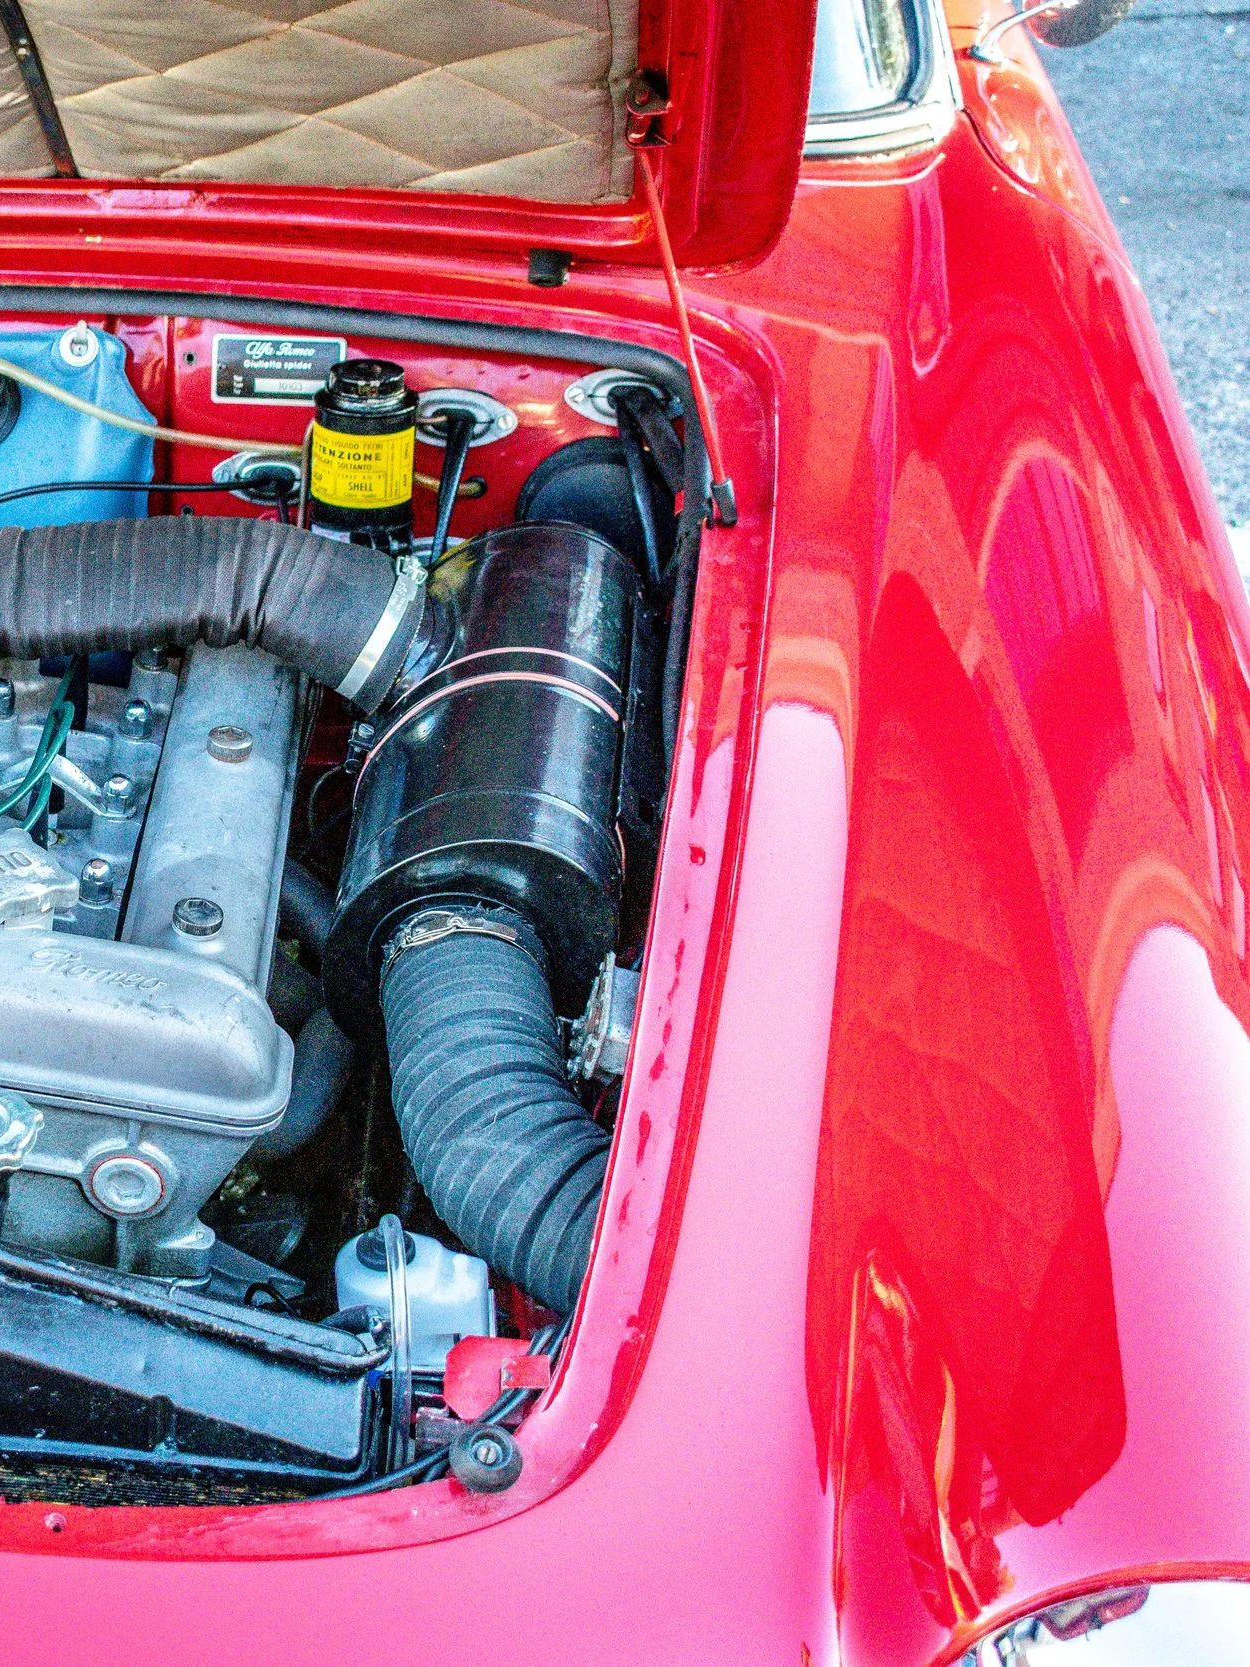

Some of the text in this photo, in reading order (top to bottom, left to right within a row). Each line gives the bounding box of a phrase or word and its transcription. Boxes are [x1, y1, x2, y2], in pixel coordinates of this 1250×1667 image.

[245, 342, 316, 359] Alfa Romeo
[243, 360, 312, 370] Giulietta spider
[348, 481, 374, 492] SHELL
[31, 946, 168, 992] Romeo
